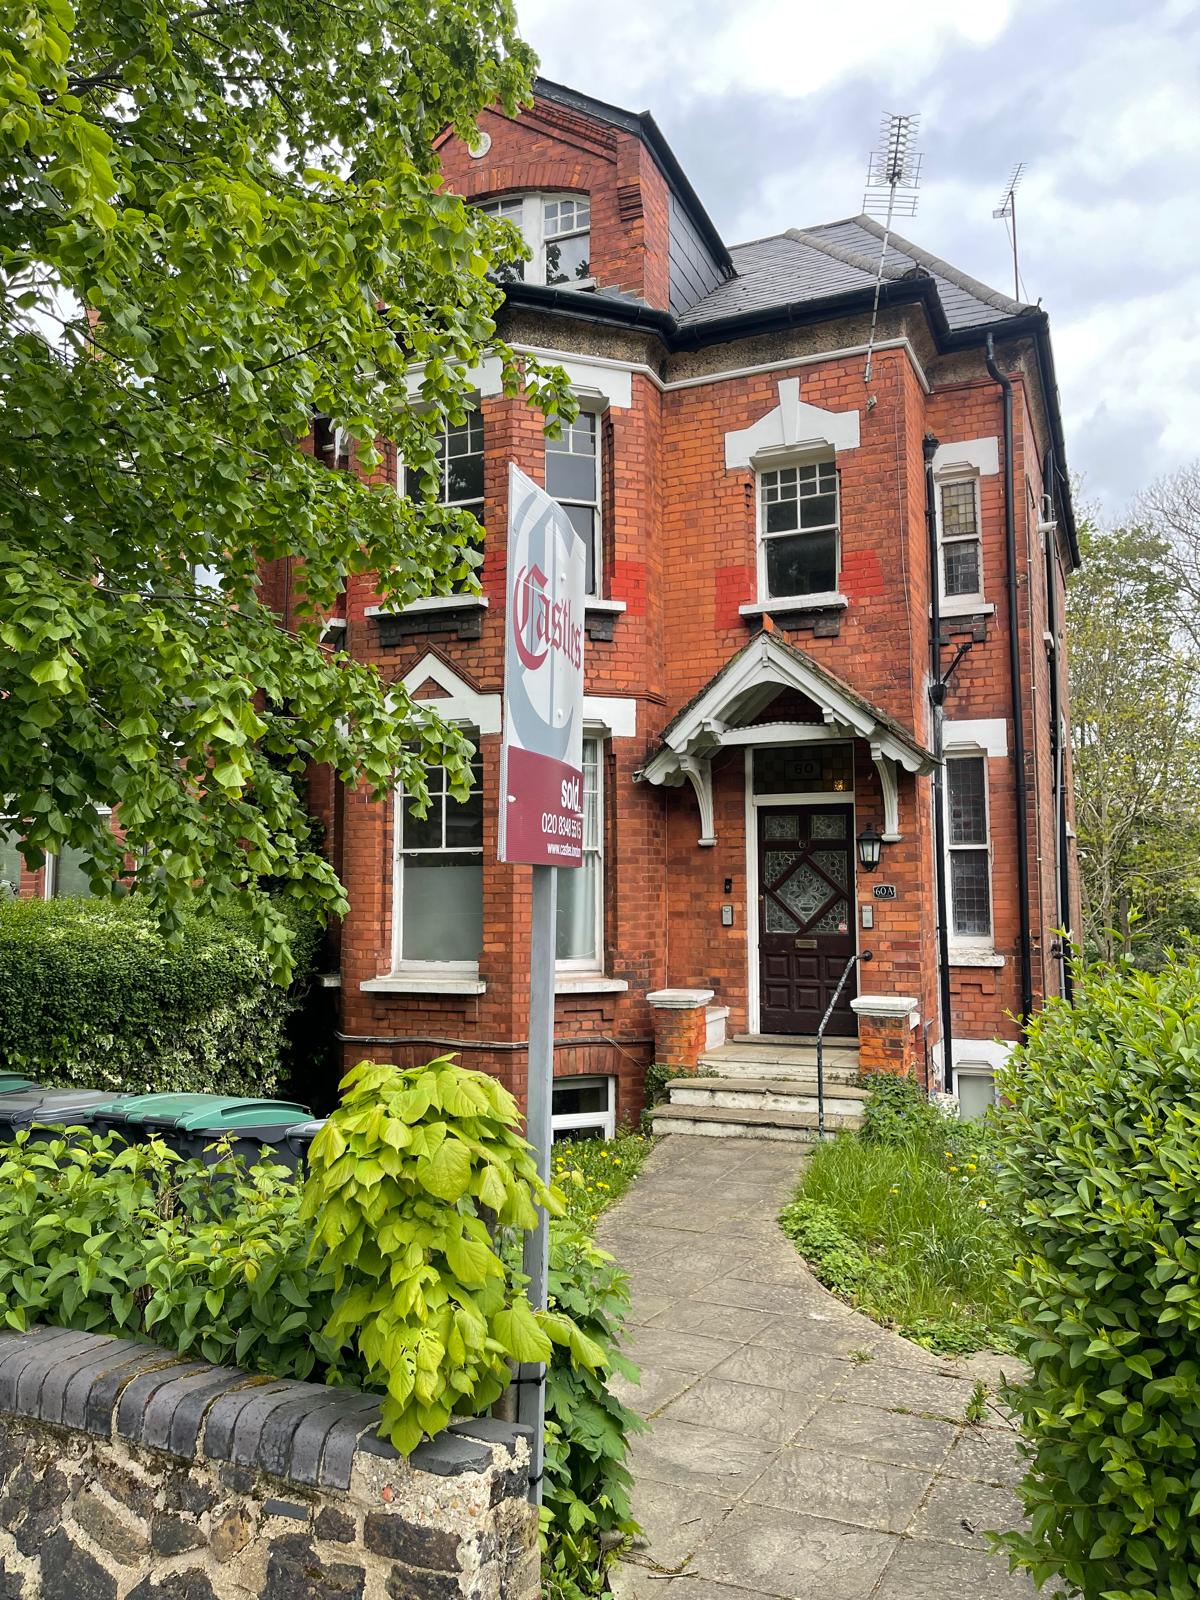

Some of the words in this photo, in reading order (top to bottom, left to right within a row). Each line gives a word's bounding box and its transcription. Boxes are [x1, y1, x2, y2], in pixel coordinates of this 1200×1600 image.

[513, 563, 581, 672] Castles
[794, 762, 814, 775] 60
[561, 776, 580, 812] sold
[541, 812, 557, 835] 020
[875, 886, 894, 896] 60A
